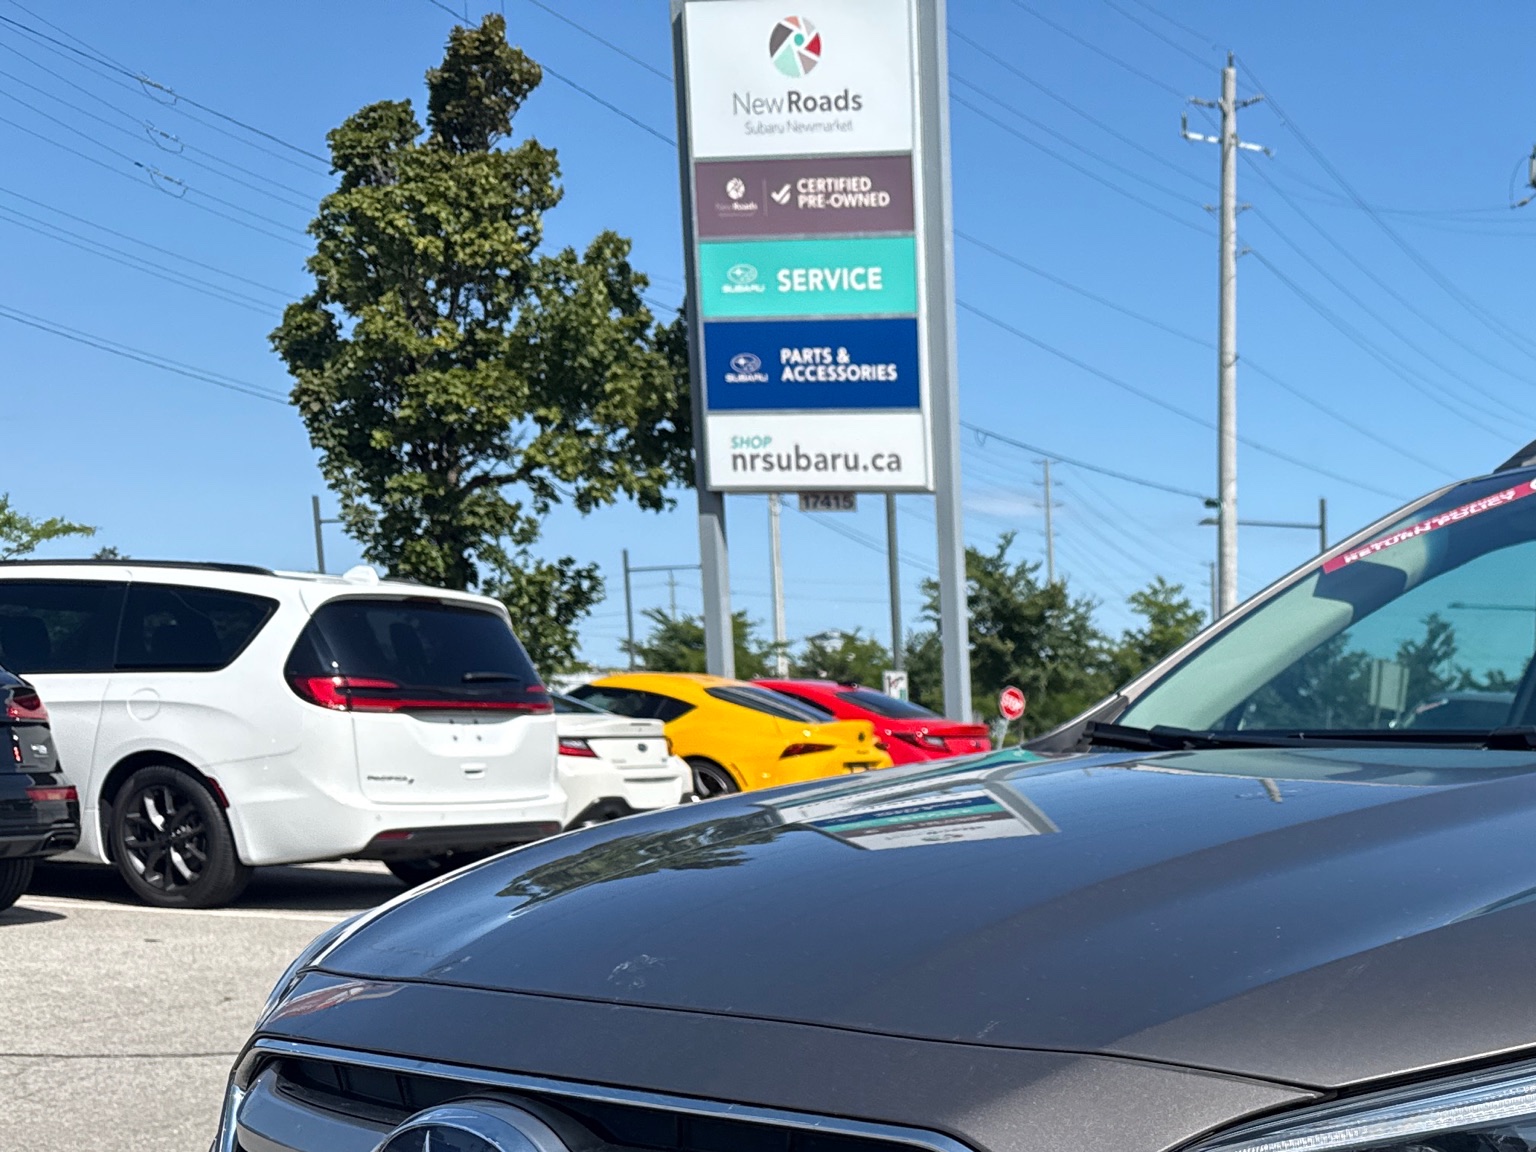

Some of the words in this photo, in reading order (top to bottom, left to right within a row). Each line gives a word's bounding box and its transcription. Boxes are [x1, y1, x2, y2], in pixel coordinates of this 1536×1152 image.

[744, 120, 785, 135] Subaru
[787, 119, 854, 133] Newmarket
[796, 176, 872, 193] CERTIFIED
[797, 191, 890, 209] PRE-OWNED
[776, 267, 882, 292] SERVICE
[780, 347, 833, 365] PARTS
[836, 346, 850, 364] &
[780, 363, 898, 382] ACCESSORIES
[731, 436, 772, 449] SHOP
[731, 444, 902, 472] nrsubaru.ca
[803, 495, 854, 509] 17415
